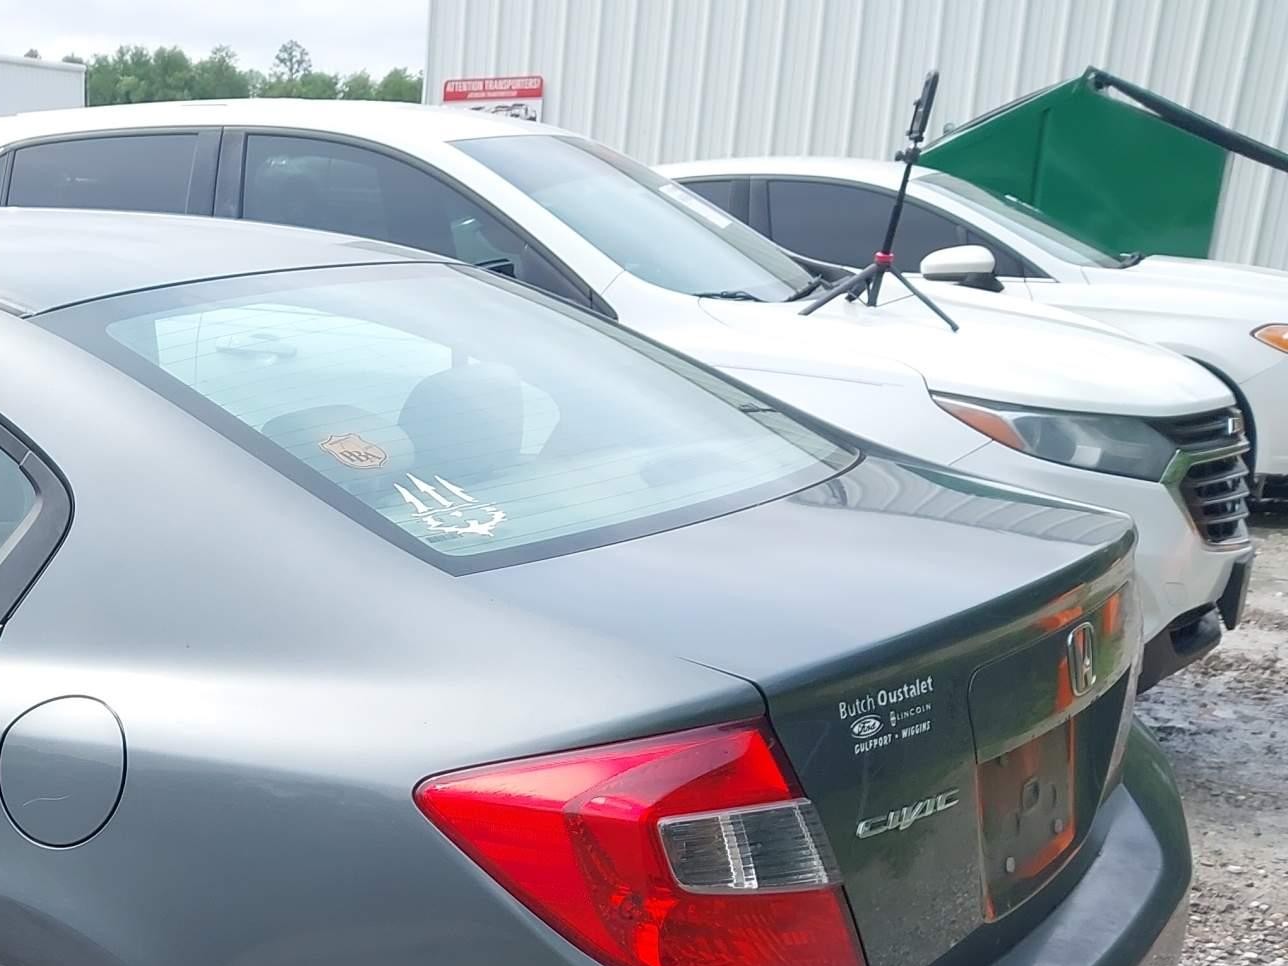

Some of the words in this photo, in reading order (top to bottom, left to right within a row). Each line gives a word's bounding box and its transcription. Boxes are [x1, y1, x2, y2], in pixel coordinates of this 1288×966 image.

[839, 694, 876, 720] Butch
[877, 675, 934, 706] Oustalet
[896, 703, 932, 721] LINCOLN
[854, 733, 892, 755] GULFPORT
[901, 720, 931, 739] WIGGINS
[856, 787, 960, 839] CIVIC
